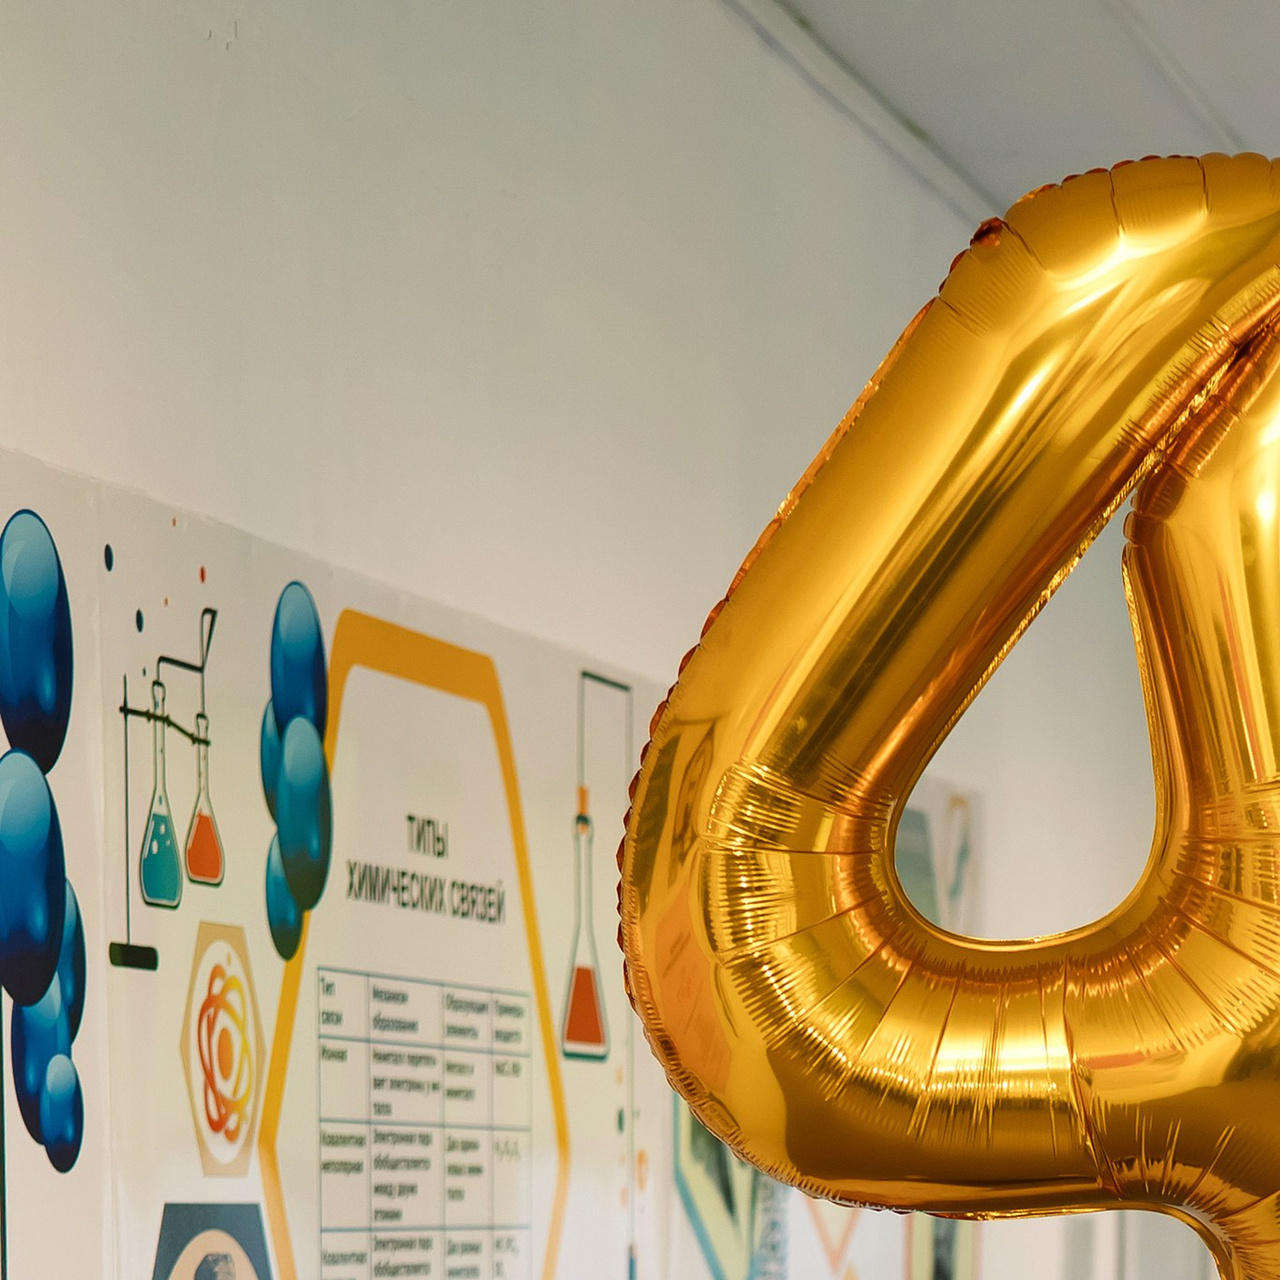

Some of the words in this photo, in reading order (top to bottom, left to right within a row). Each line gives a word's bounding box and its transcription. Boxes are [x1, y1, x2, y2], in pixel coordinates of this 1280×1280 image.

[407, 813, 449, 859] ТИПЫ
[346, 860, 446, 914] ХИМИЧЕСКИХ
[450, 879, 506, 925] СВЯЗЕЙ
